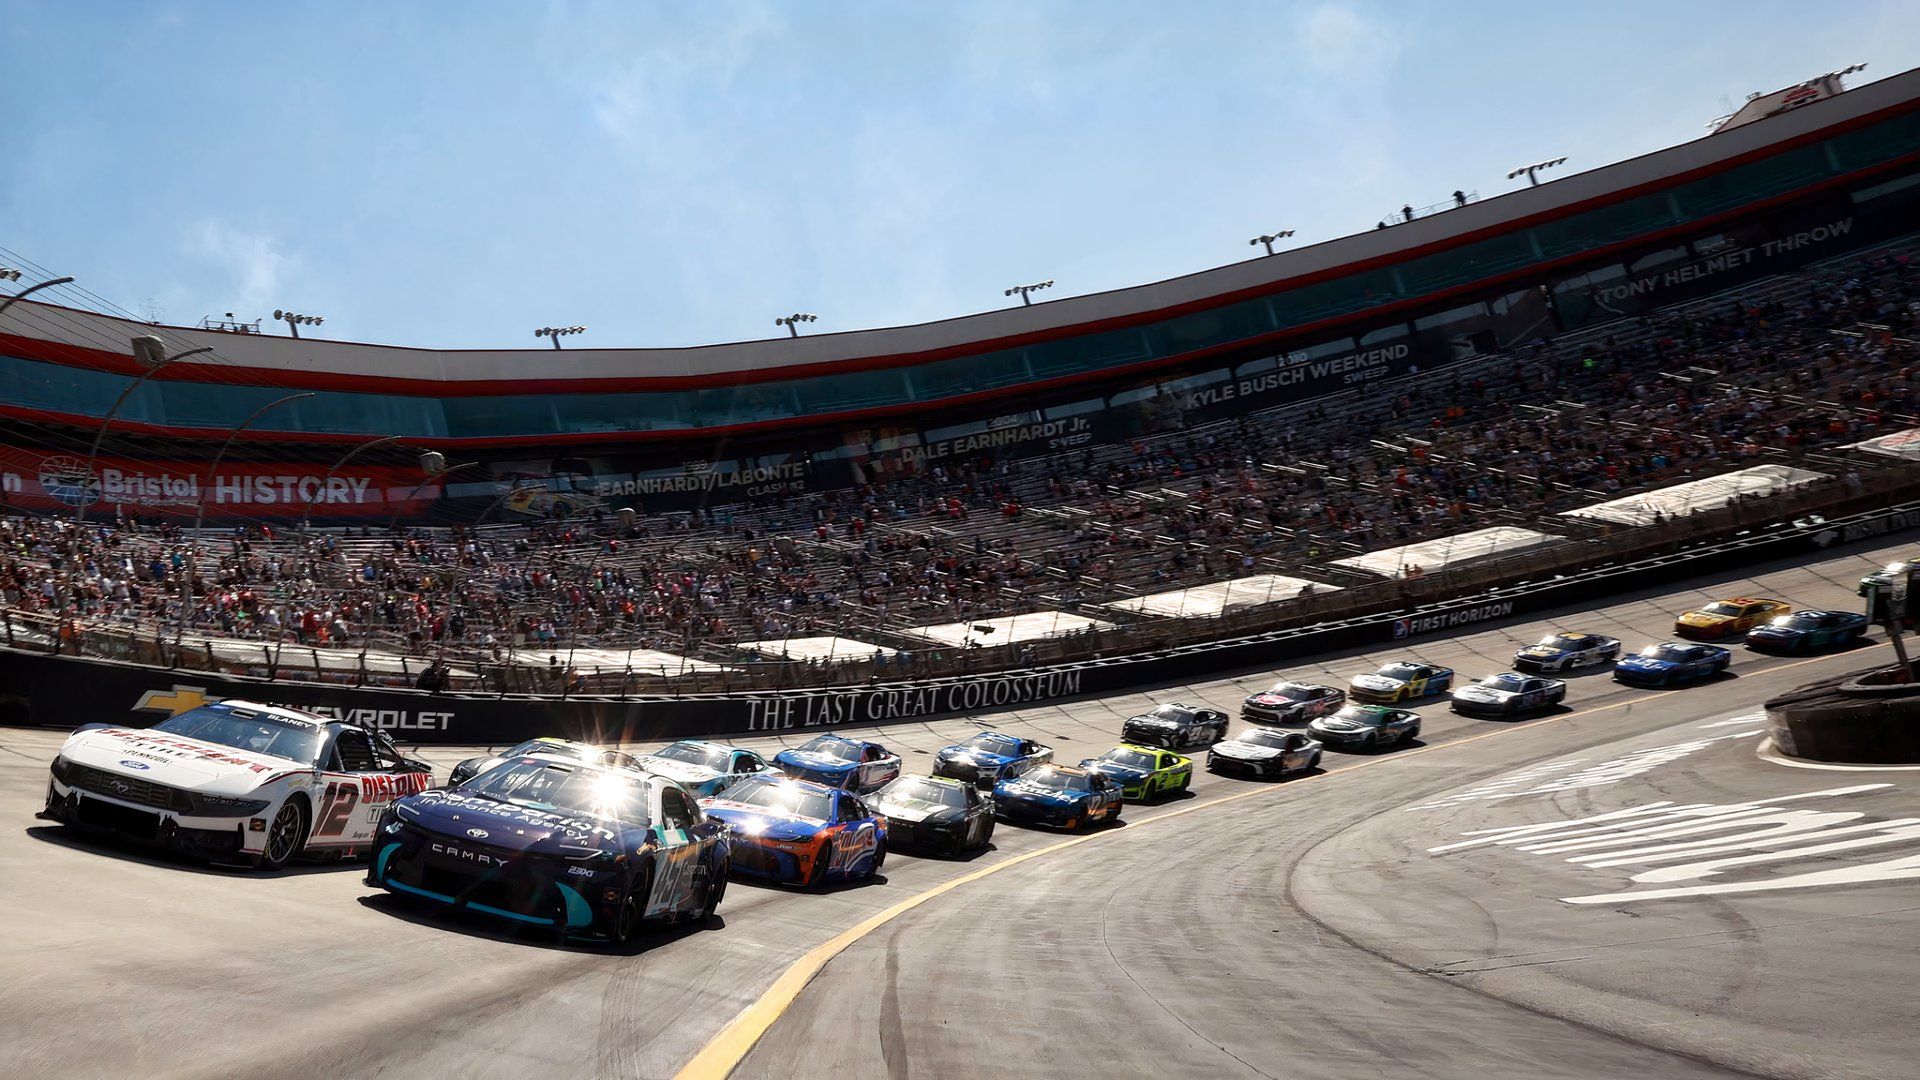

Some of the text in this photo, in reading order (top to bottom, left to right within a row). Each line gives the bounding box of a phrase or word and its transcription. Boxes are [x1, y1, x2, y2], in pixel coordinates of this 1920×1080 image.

[1601, 216, 1856, 303] TONY HELMET THROW
[1185, 344, 1410, 410] KYLE BUSCH WEEKEND
[1343, 365, 1390, 385] SWEEP
[901, 416, 1092, 463] DALE EARNHARDT Jr.
[1049, 432, 1092, 449] SWEEP
[103, 468, 198, 497] Bristol
[215, 474, 372, 504] HISTORY
[600, 462, 804, 497] EARNHARDT/LABONTE
[1409, 613, 1449, 634] FIRST
[1449, 601, 1514, 626] HORIZON
[746, 670, 1082, 731] THE LAST GREAT COLOSSEUM
[266, 714, 313, 729] BLANEY
[311, 781, 359, 837] 12
